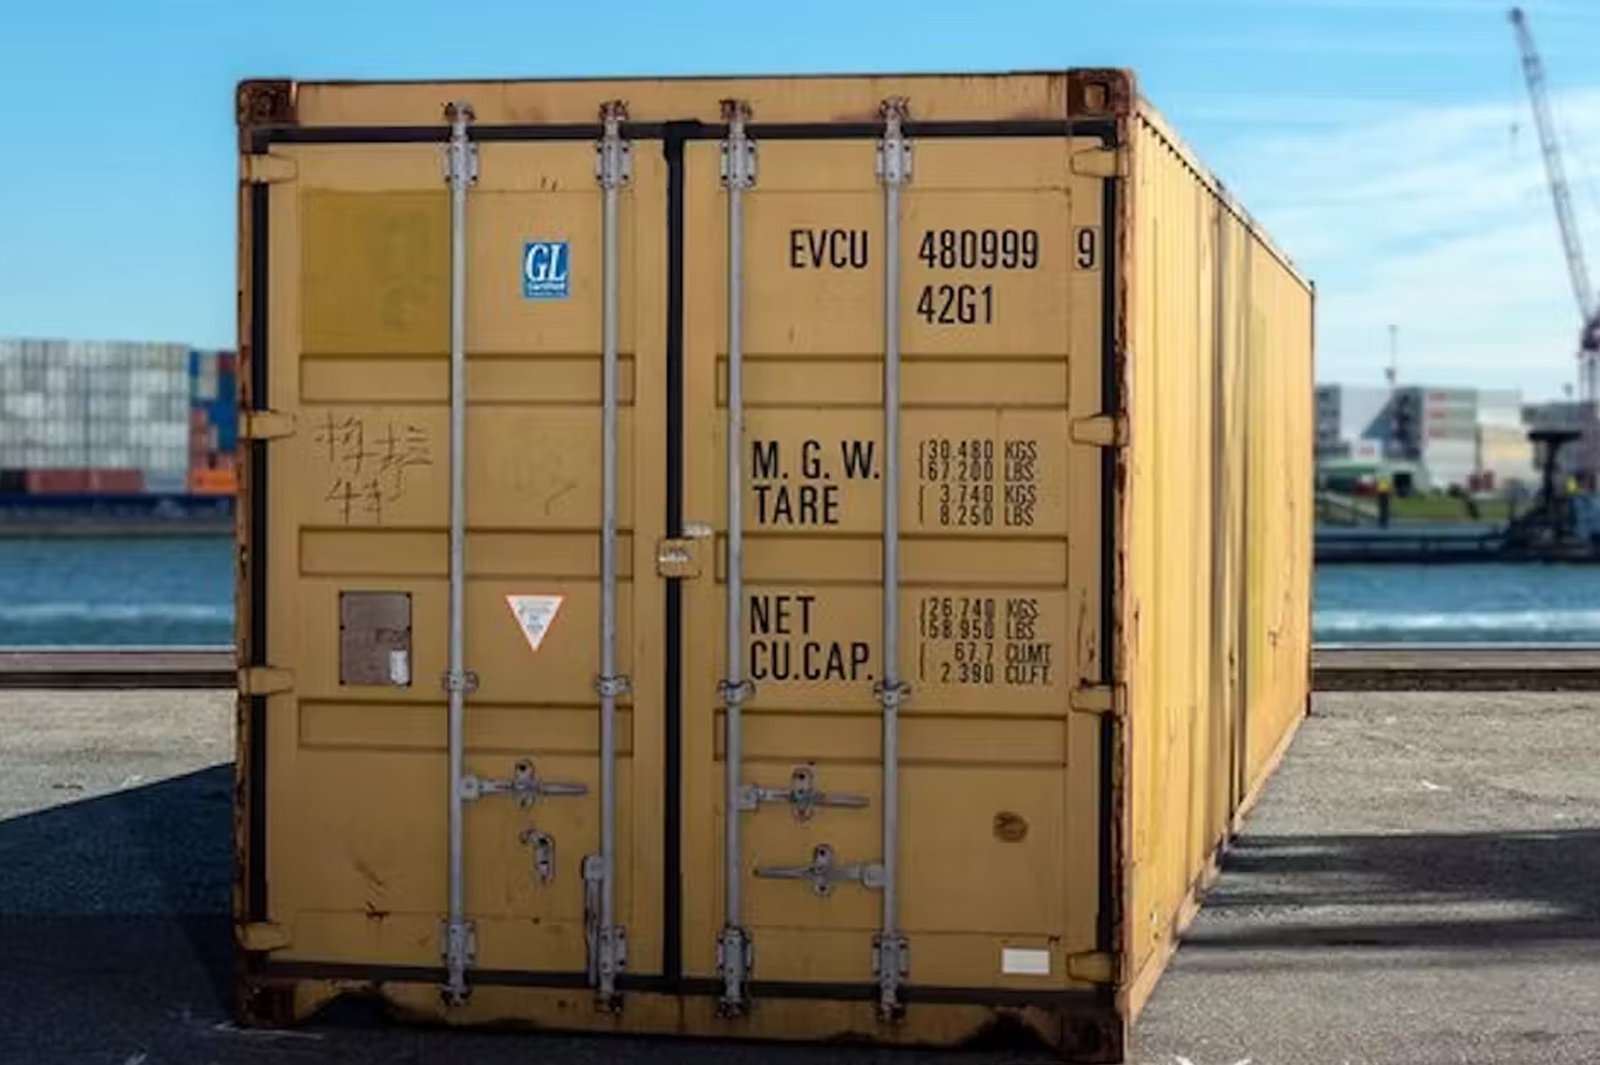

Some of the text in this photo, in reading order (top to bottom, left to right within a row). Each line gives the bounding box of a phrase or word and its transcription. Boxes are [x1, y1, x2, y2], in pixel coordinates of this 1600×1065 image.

[525, 243, 567, 281] GL
[789, 228, 1096, 269] EVCU 480999 9
[917, 284, 993, 324] 42G1
[1004, 440, 1038, 461] KGS
[752, 485, 839, 525] TARE
[1004, 484, 1038, 504] KGS
[1004, 505, 1035, 526] LBS
[750, 595, 815, 635] NET
[750, 641, 873, 681] CU.CAP.
